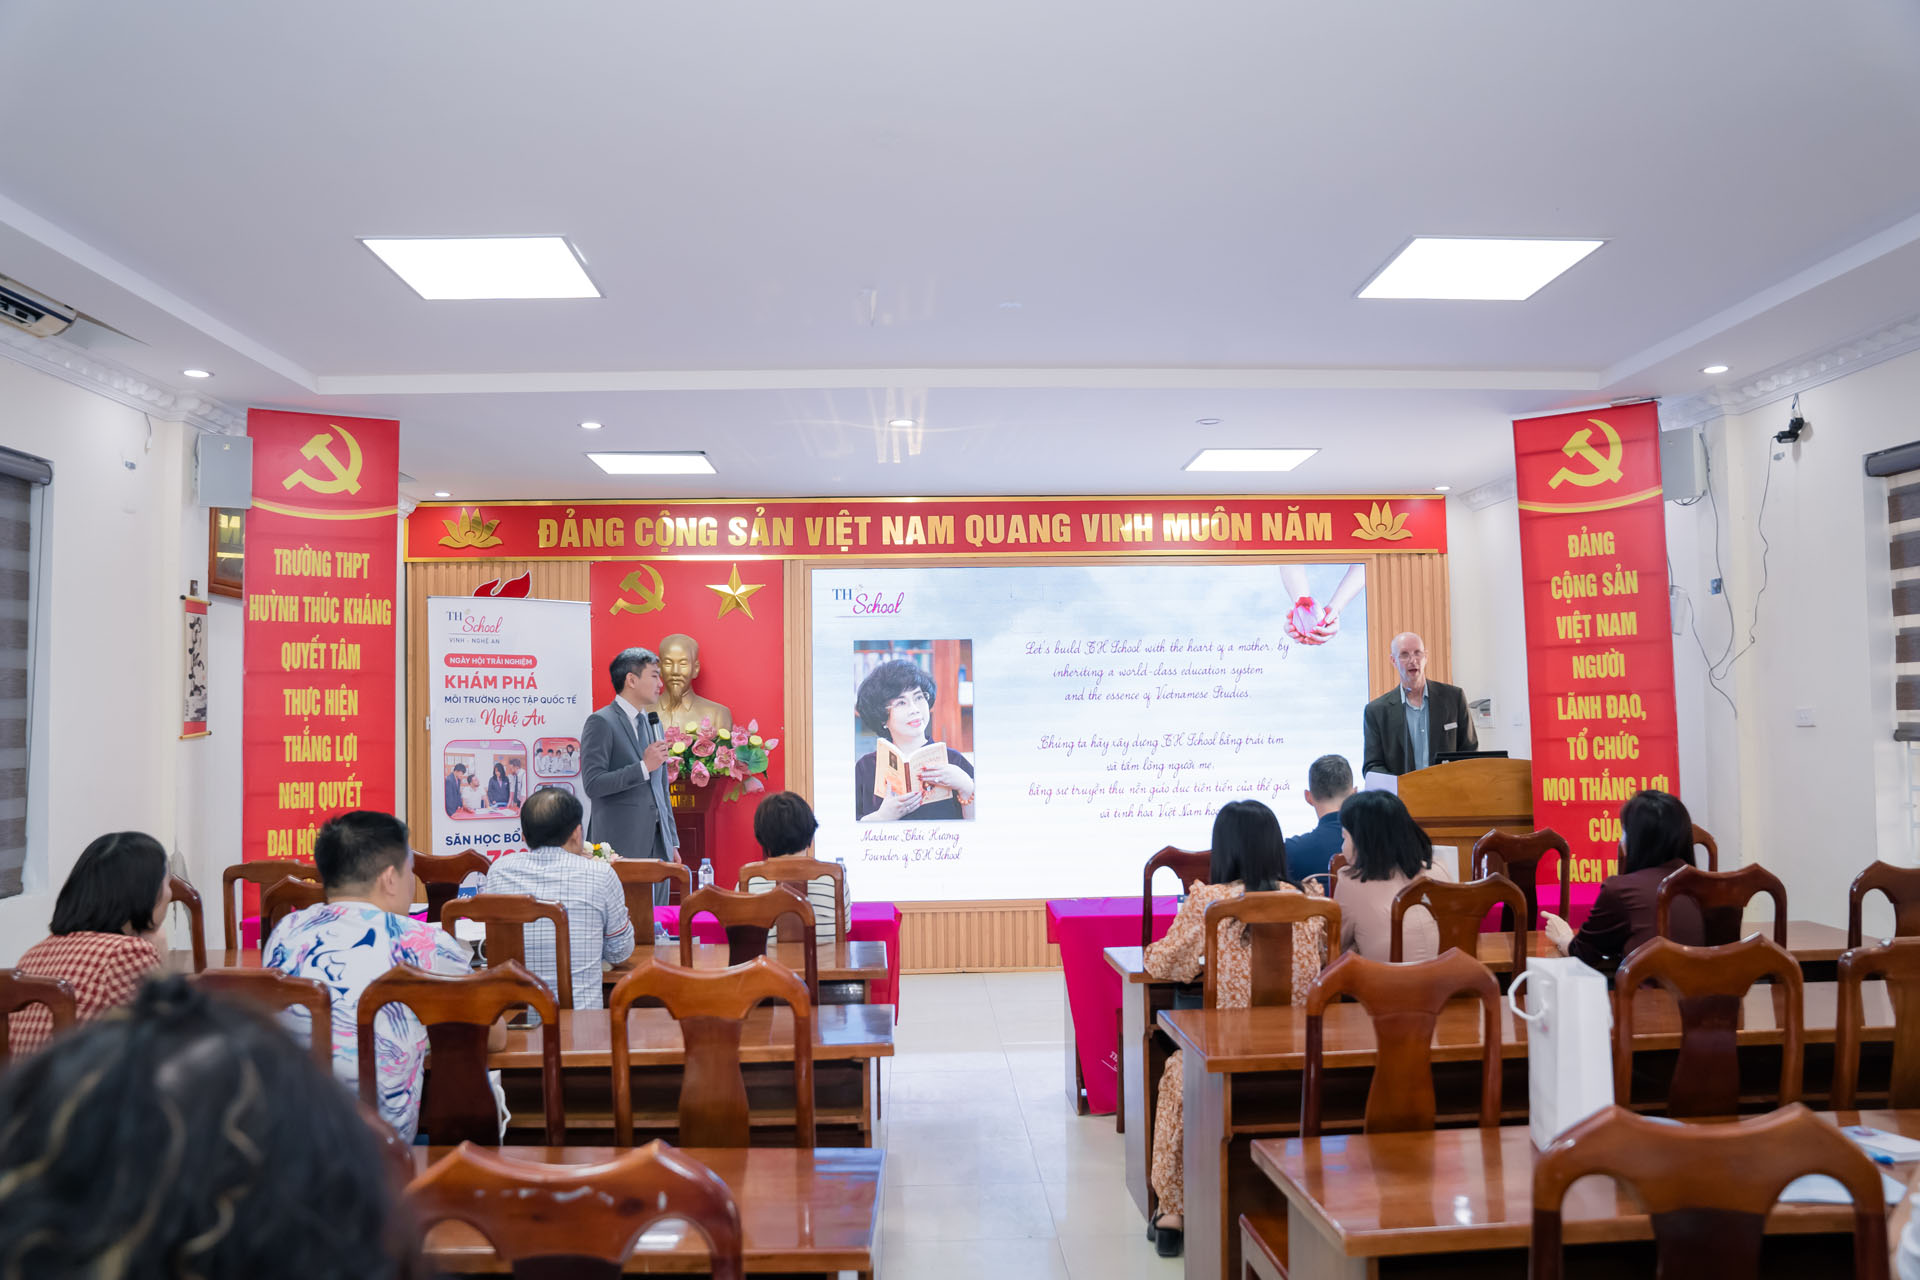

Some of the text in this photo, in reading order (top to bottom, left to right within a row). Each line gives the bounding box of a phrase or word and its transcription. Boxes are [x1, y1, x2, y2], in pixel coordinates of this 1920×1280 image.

[538, 505, 1332, 553] ĐẢNG CỘNG SẢN VIỆT NAM QUANG VINH MUÔN NĂM
[1568, 526, 1615, 558] ĐẢNG
[274, 544, 370, 580] TRƯỜNG THPT
[1551, 564, 1638, 604] CỘNG SẢN
[249, 589, 392, 626] HUỲNH THÚC KHÁNG
[832, 588, 905, 614] TH School
[446, 611, 504, 633] TH School
[1556, 611, 1638, 644] VIỆT NAM
[281, 634, 361, 672] QUYẾT TÂM
[449, 655, 533, 666] NGÀY HỘI TRẢI NGHIỆM
[1055, 640, 1081, 654] build
[1145, 639, 1165, 653] with
[1170, 638, 1183, 652] the
[1187, 638, 1212, 652] heart
[1277, 637, 1289, 659] by
[1053, 663, 1104, 686] inheriting
[1119, 662, 1177, 677] world-class
[1181, 661, 1226, 676] education
[1231, 664, 1263, 683] system
[1572, 649, 1625, 679] NGƯỜI
[444, 671, 538, 690] KHÁM PHÁ
[1065, 687, 1084, 701] and
[1088, 687, 1102, 701] the
[1106, 692, 1140, 701] essence
[1156, 683, 1208, 700] Vietnamese
[283, 684, 358, 722] THỰC HIỆN
[464, 694, 500, 704] TRƯỜNG
[502, 696, 521, 705] HỌC
[523, 695, 538, 705] TẬP
[540, 694, 565, 704] QUỐC
[567, 694, 577, 704] TẾ
[1557, 693, 1647, 724] LÃNH ĐẠO,
[480, 708, 519, 734] Nghệ
[522, 708, 546, 727] An
[283, 726, 358, 767] THẮNG LỢI
[1077, 737, 1087, 748] ta
[1245, 734, 1264, 745] trái
[1268, 735, 1284, 745] tim
[1567, 727, 1639, 760] TỔ CHỨC
[278, 774, 362, 814] NGHỊ QUYẾT
[1543, 777, 1576, 806] MỌI
[1580, 769, 1636, 801] THẮNG
[1114, 804, 1134, 818] tinh
[1137, 804, 1153, 818] hoa
[1178, 803, 1202, 817] Nam
[446, 828, 524, 847] SĂN HỌC BỔ
[860, 828, 899, 842] Madame
[1589, 810, 1623, 842] CỦA
[267, 829, 293, 860] ĐẠI
[862, 848, 899, 861] Founder
